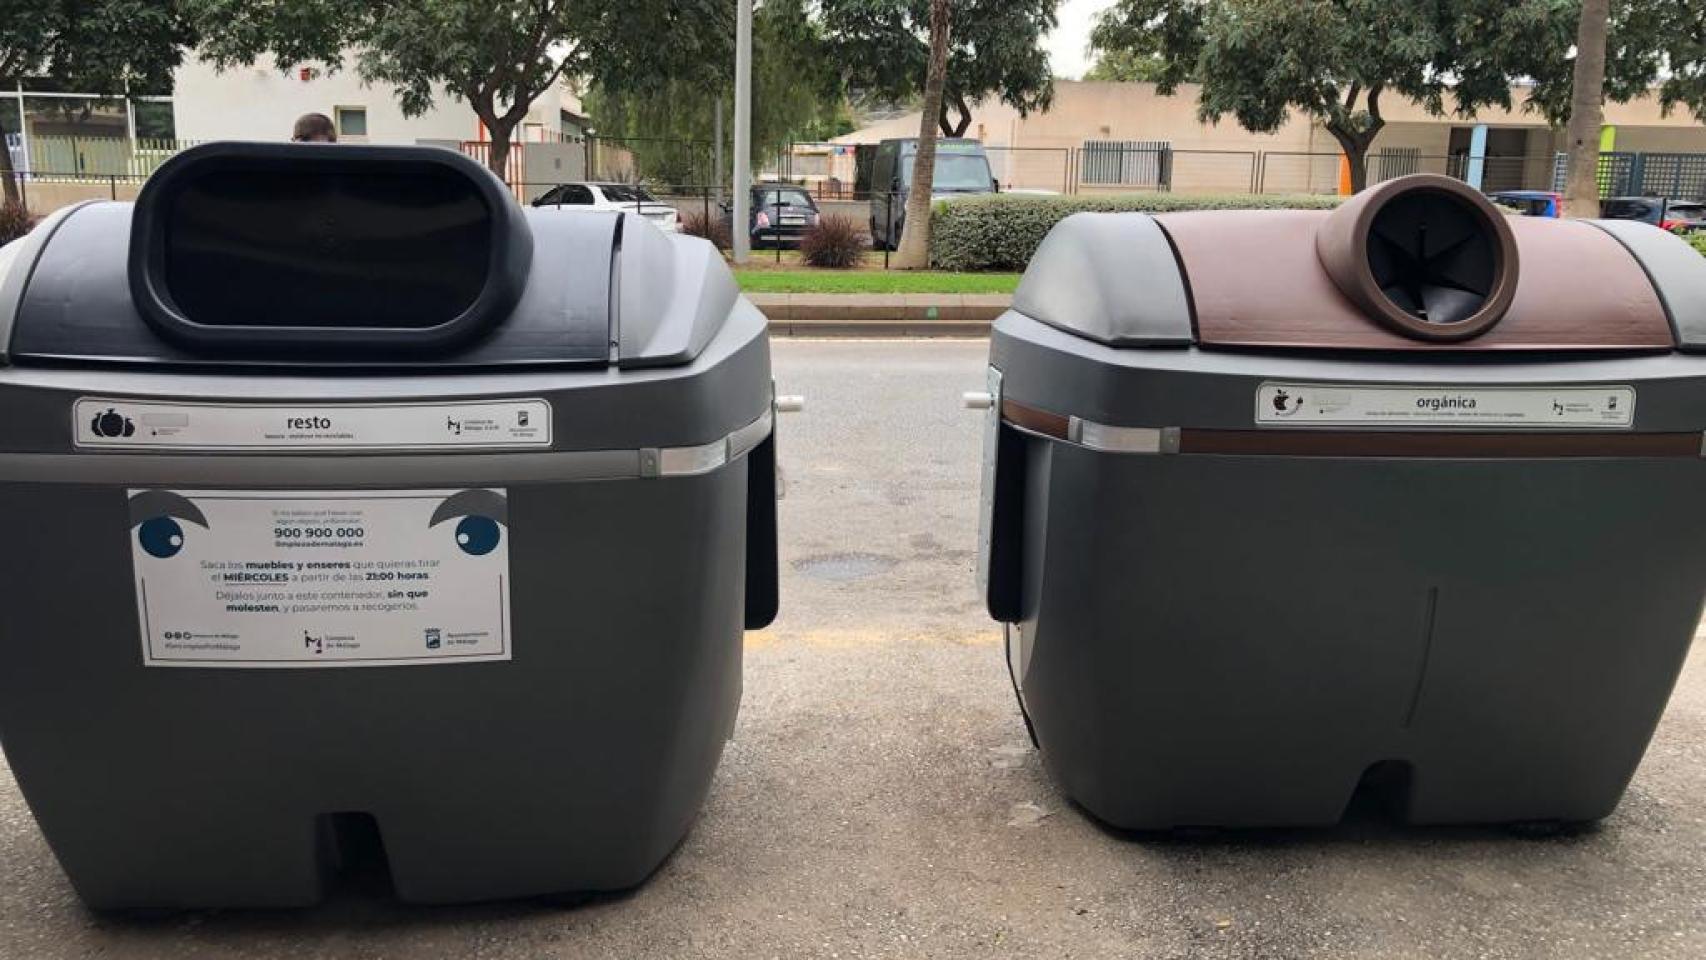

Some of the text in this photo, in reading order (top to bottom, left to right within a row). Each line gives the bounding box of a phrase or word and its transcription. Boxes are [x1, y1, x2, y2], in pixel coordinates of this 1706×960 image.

[1416, 394, 1476, 410] orgánica
[287, 415, 331, 429] resto
[274, 527, 364, 538] 900 900 000
[200, 558, 440, 571] Saca los muebles y enseres que quieras tirar
[211, 573, 221, 582] el
[223, 571, 289, 582] MIÉRCOLES
[300, 573, 329, 584] partir
[332, 572, 347, 581] de
[349, 572, 364, 581] las
[365, 572, 394, 581] 21:00
[216, 589, 255, 602] Déjalos
[256, 590, 285, 602] junto
[295, 591, 319, 600] este
[387, 589, 404, 599] sin
[406, 590, 429, 600] que
[282, 605, 290, 614] y
[292, 603, 351, 614] pasaremos
